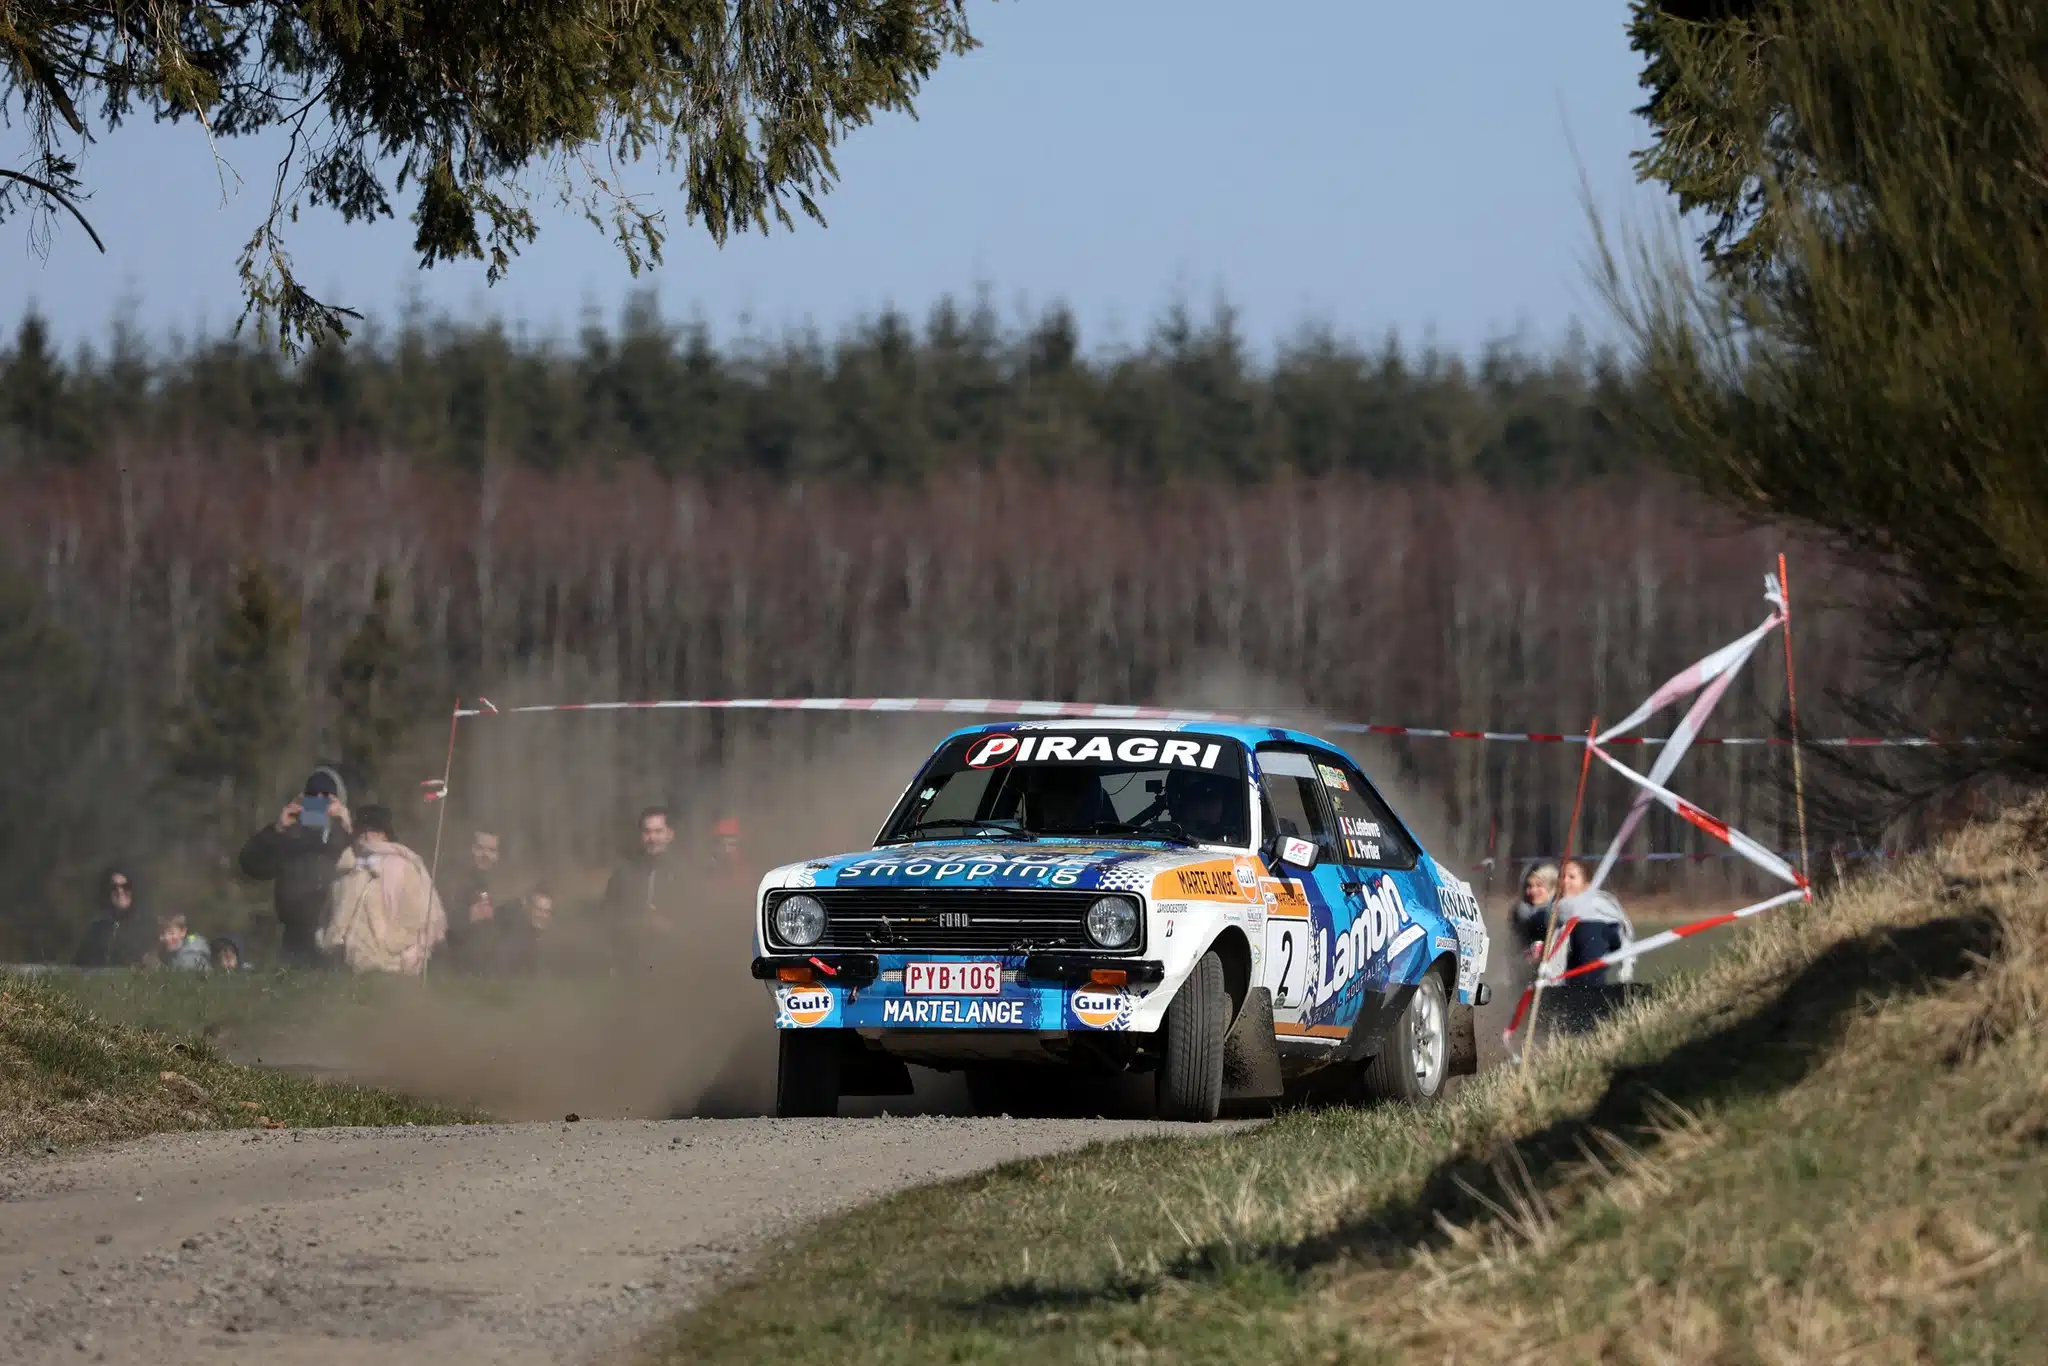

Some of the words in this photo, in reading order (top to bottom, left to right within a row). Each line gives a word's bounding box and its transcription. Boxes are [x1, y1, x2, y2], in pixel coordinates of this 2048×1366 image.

[968, 735, 1221, 769] PIRAGRI
[840, 860, 1085, 885] shopping
[1176, 871, 1238, 895] MARTELANGE
[1236, 869, 1255, 885] Gulf
[939, 912, 969, 928] FORD
[1315, 874, 1409, 1008] Lambin
[1276, 930, 1293, 997] 2
[785, 996, 831, 1010] Gulf
[883, 999, 1024, 1024] MARTELANGE
[1074, 996, 1122, 1010] Gulf
